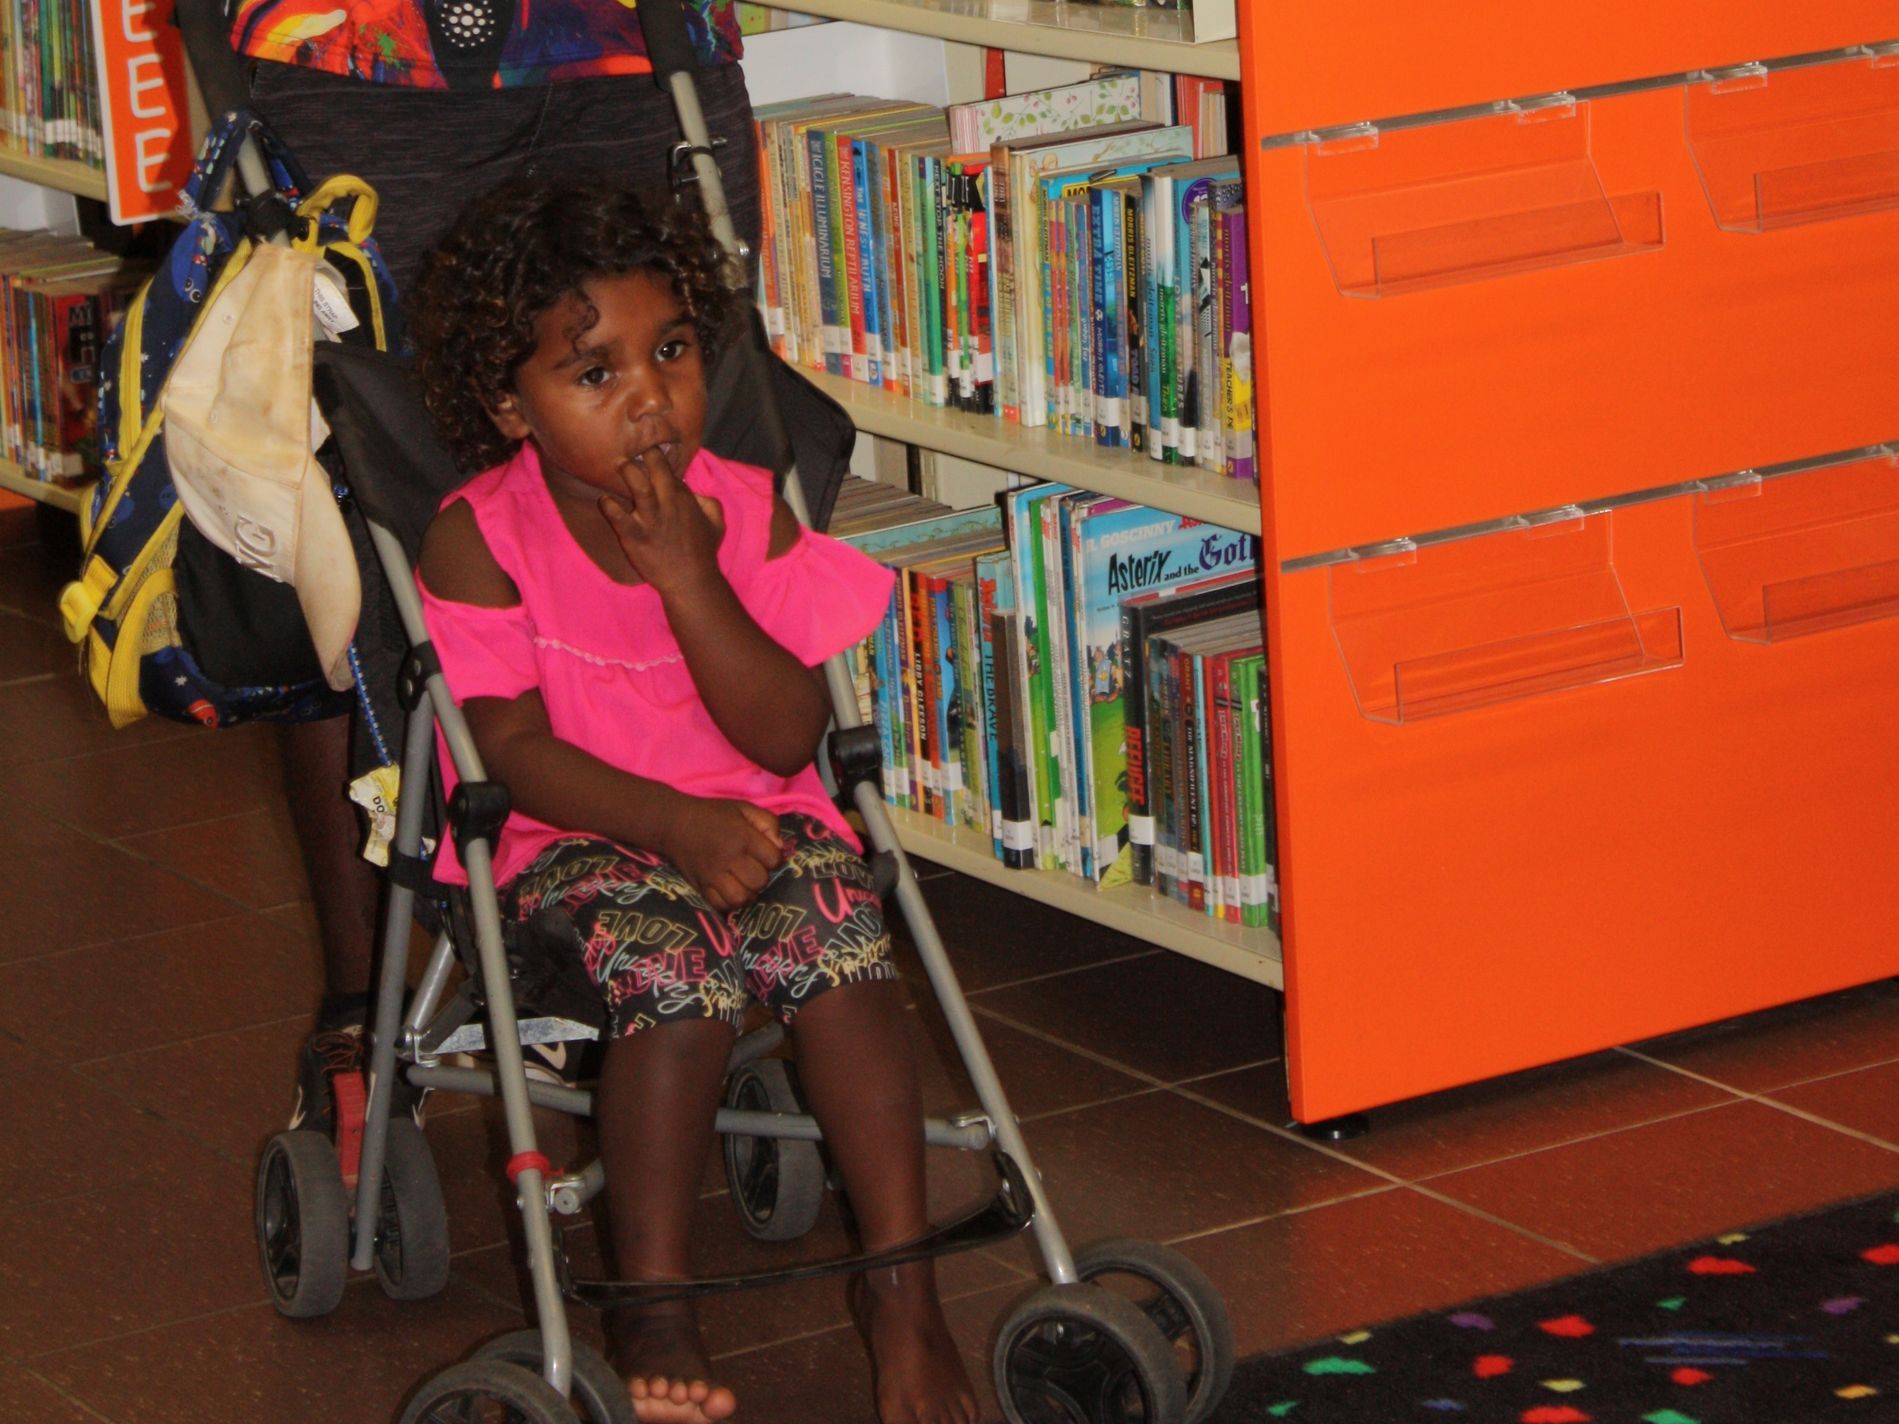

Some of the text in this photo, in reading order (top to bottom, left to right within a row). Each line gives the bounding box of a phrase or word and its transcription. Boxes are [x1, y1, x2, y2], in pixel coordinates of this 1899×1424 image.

[813, 153, 832, 279] ICICLE ILLUMINARIUM
[841, 160, 860, 314] KENSINGTON REPTILARIUM
[1092, 205, 1103, 259] EXTRA
[1094, 266, 1104, 304] TIME
[1126, 208, 1139, 383] MORRIS GLEITZMAN TOAD
[1174, 276, 1182, 319] LOYAL
[1222, 228, 1235, 333] morris gleitzman
[1145, 280, 1155, 338] gleitzman
[1160, 324, 1168, 374] gleitzman
[1225, 361, 1235, 414] TEACHER'S
[1101, 519, 1176, 547] GOSCINNY
[1108, 550, 1173, 596] Asterix
[1164, 567, 1182, 582] and
[1183, 563, 1200, 576] the
[1121, 615, 1132, 679] GRATZ
[1183, 657, 1192, 691] GRANT
[915, 652, 927, 741] LIBBY GLEESON
[986, 687, 998, 742] BRAVE
[1126, 724, 1145, 807] REFUGEE
[1187, 745, 1197, 811] MAGNIFICENT
